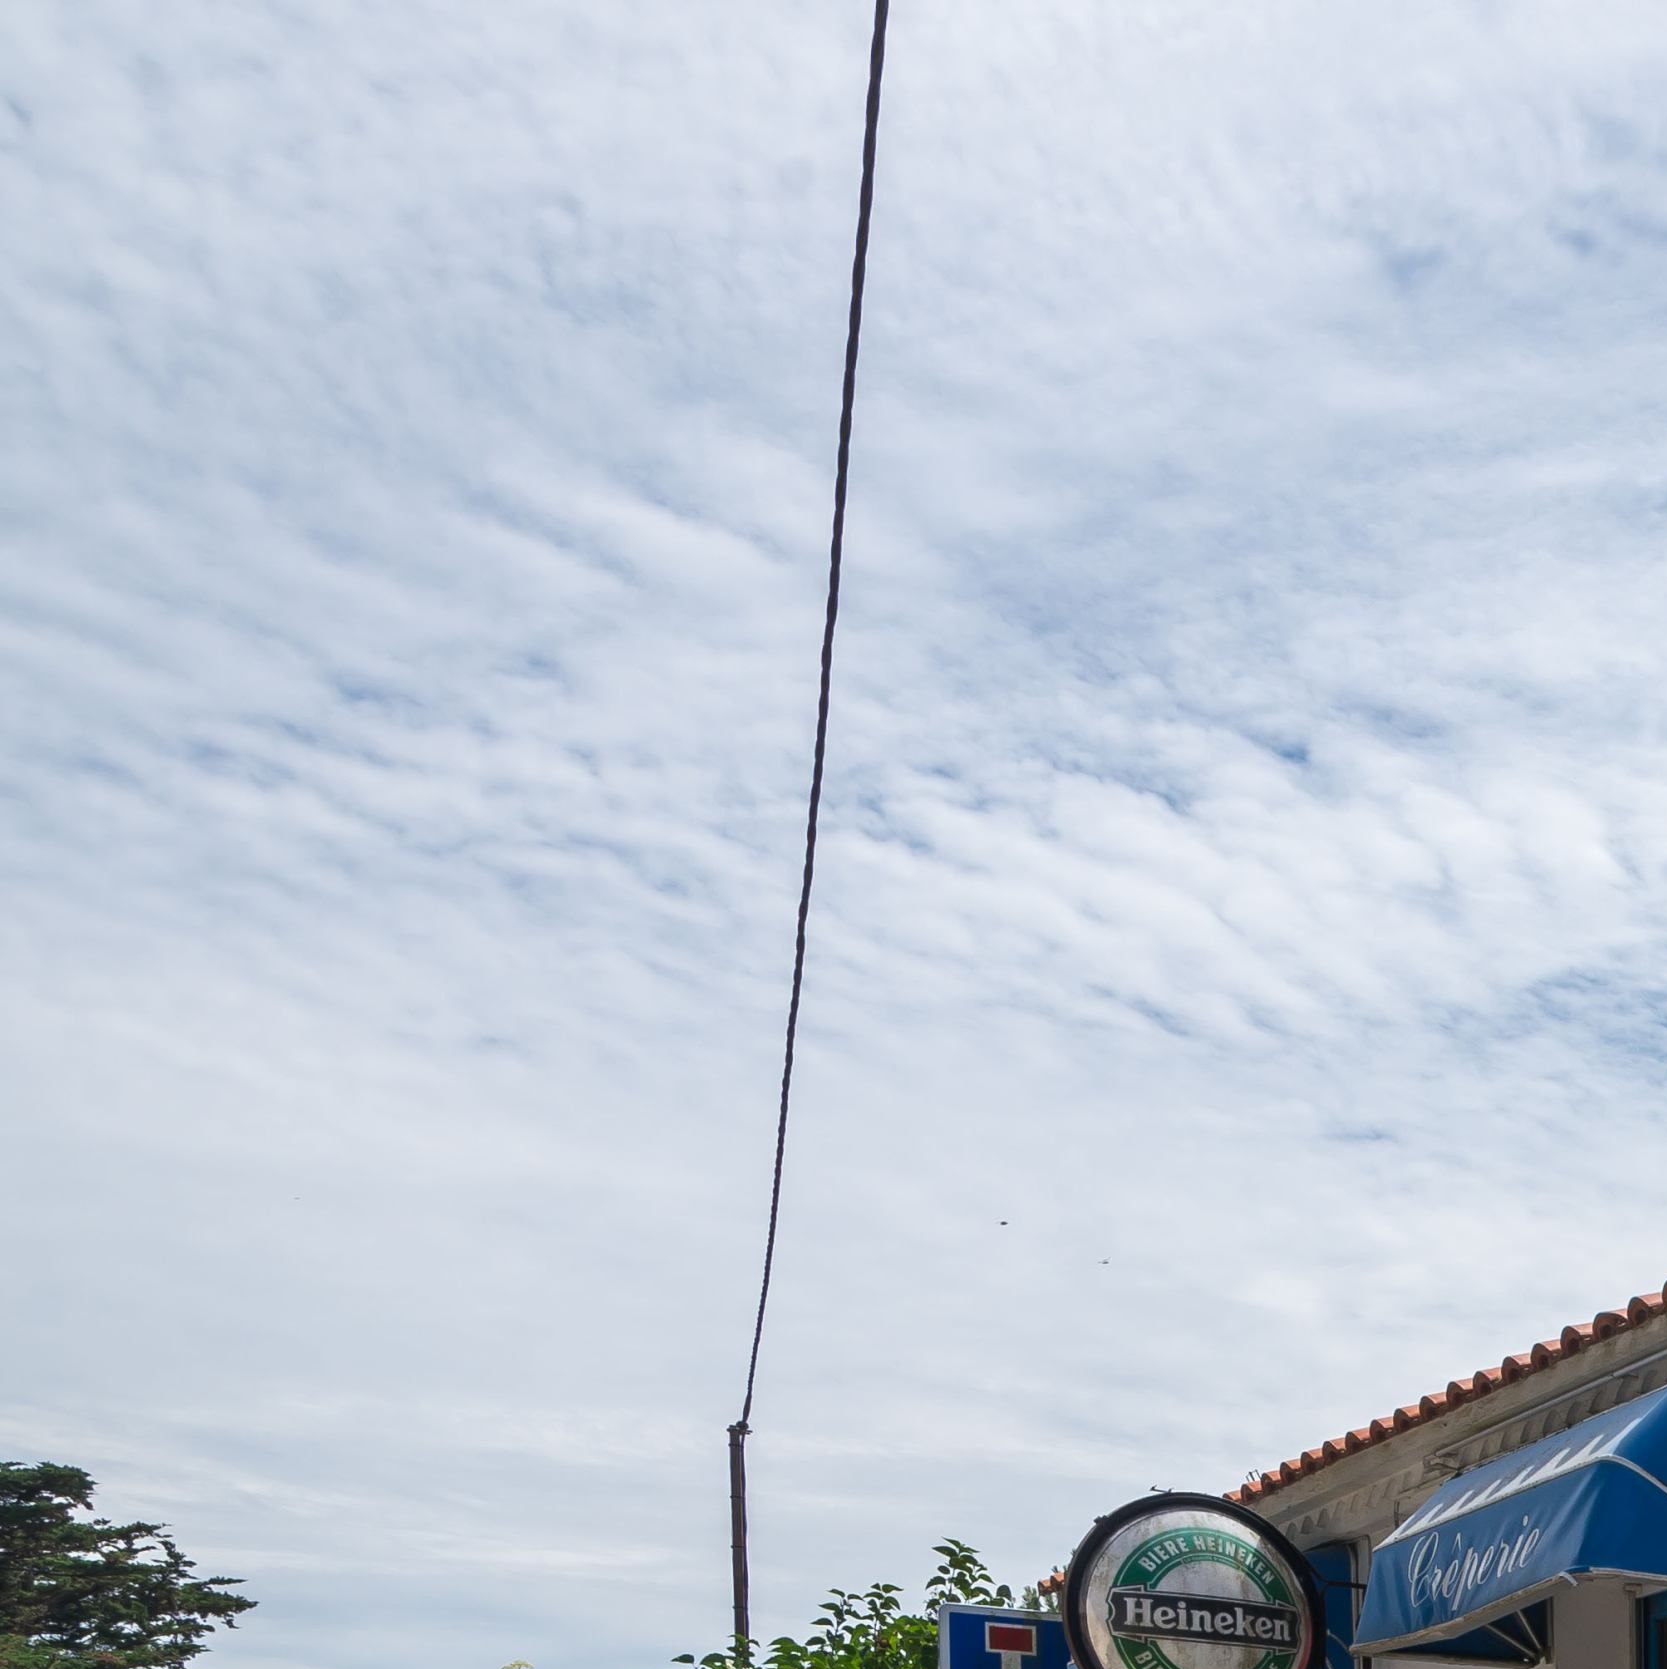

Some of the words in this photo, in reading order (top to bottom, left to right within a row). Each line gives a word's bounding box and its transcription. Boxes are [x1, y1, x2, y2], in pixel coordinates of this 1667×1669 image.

[1140, 1537, 1188, 1573] BIERE
[1193, 1535, 1276, 1585] HEINEKEN
[1408, 1514, 1541, 1612] Crêperie
[1123, 1597, 1292, 1641] Heineken
